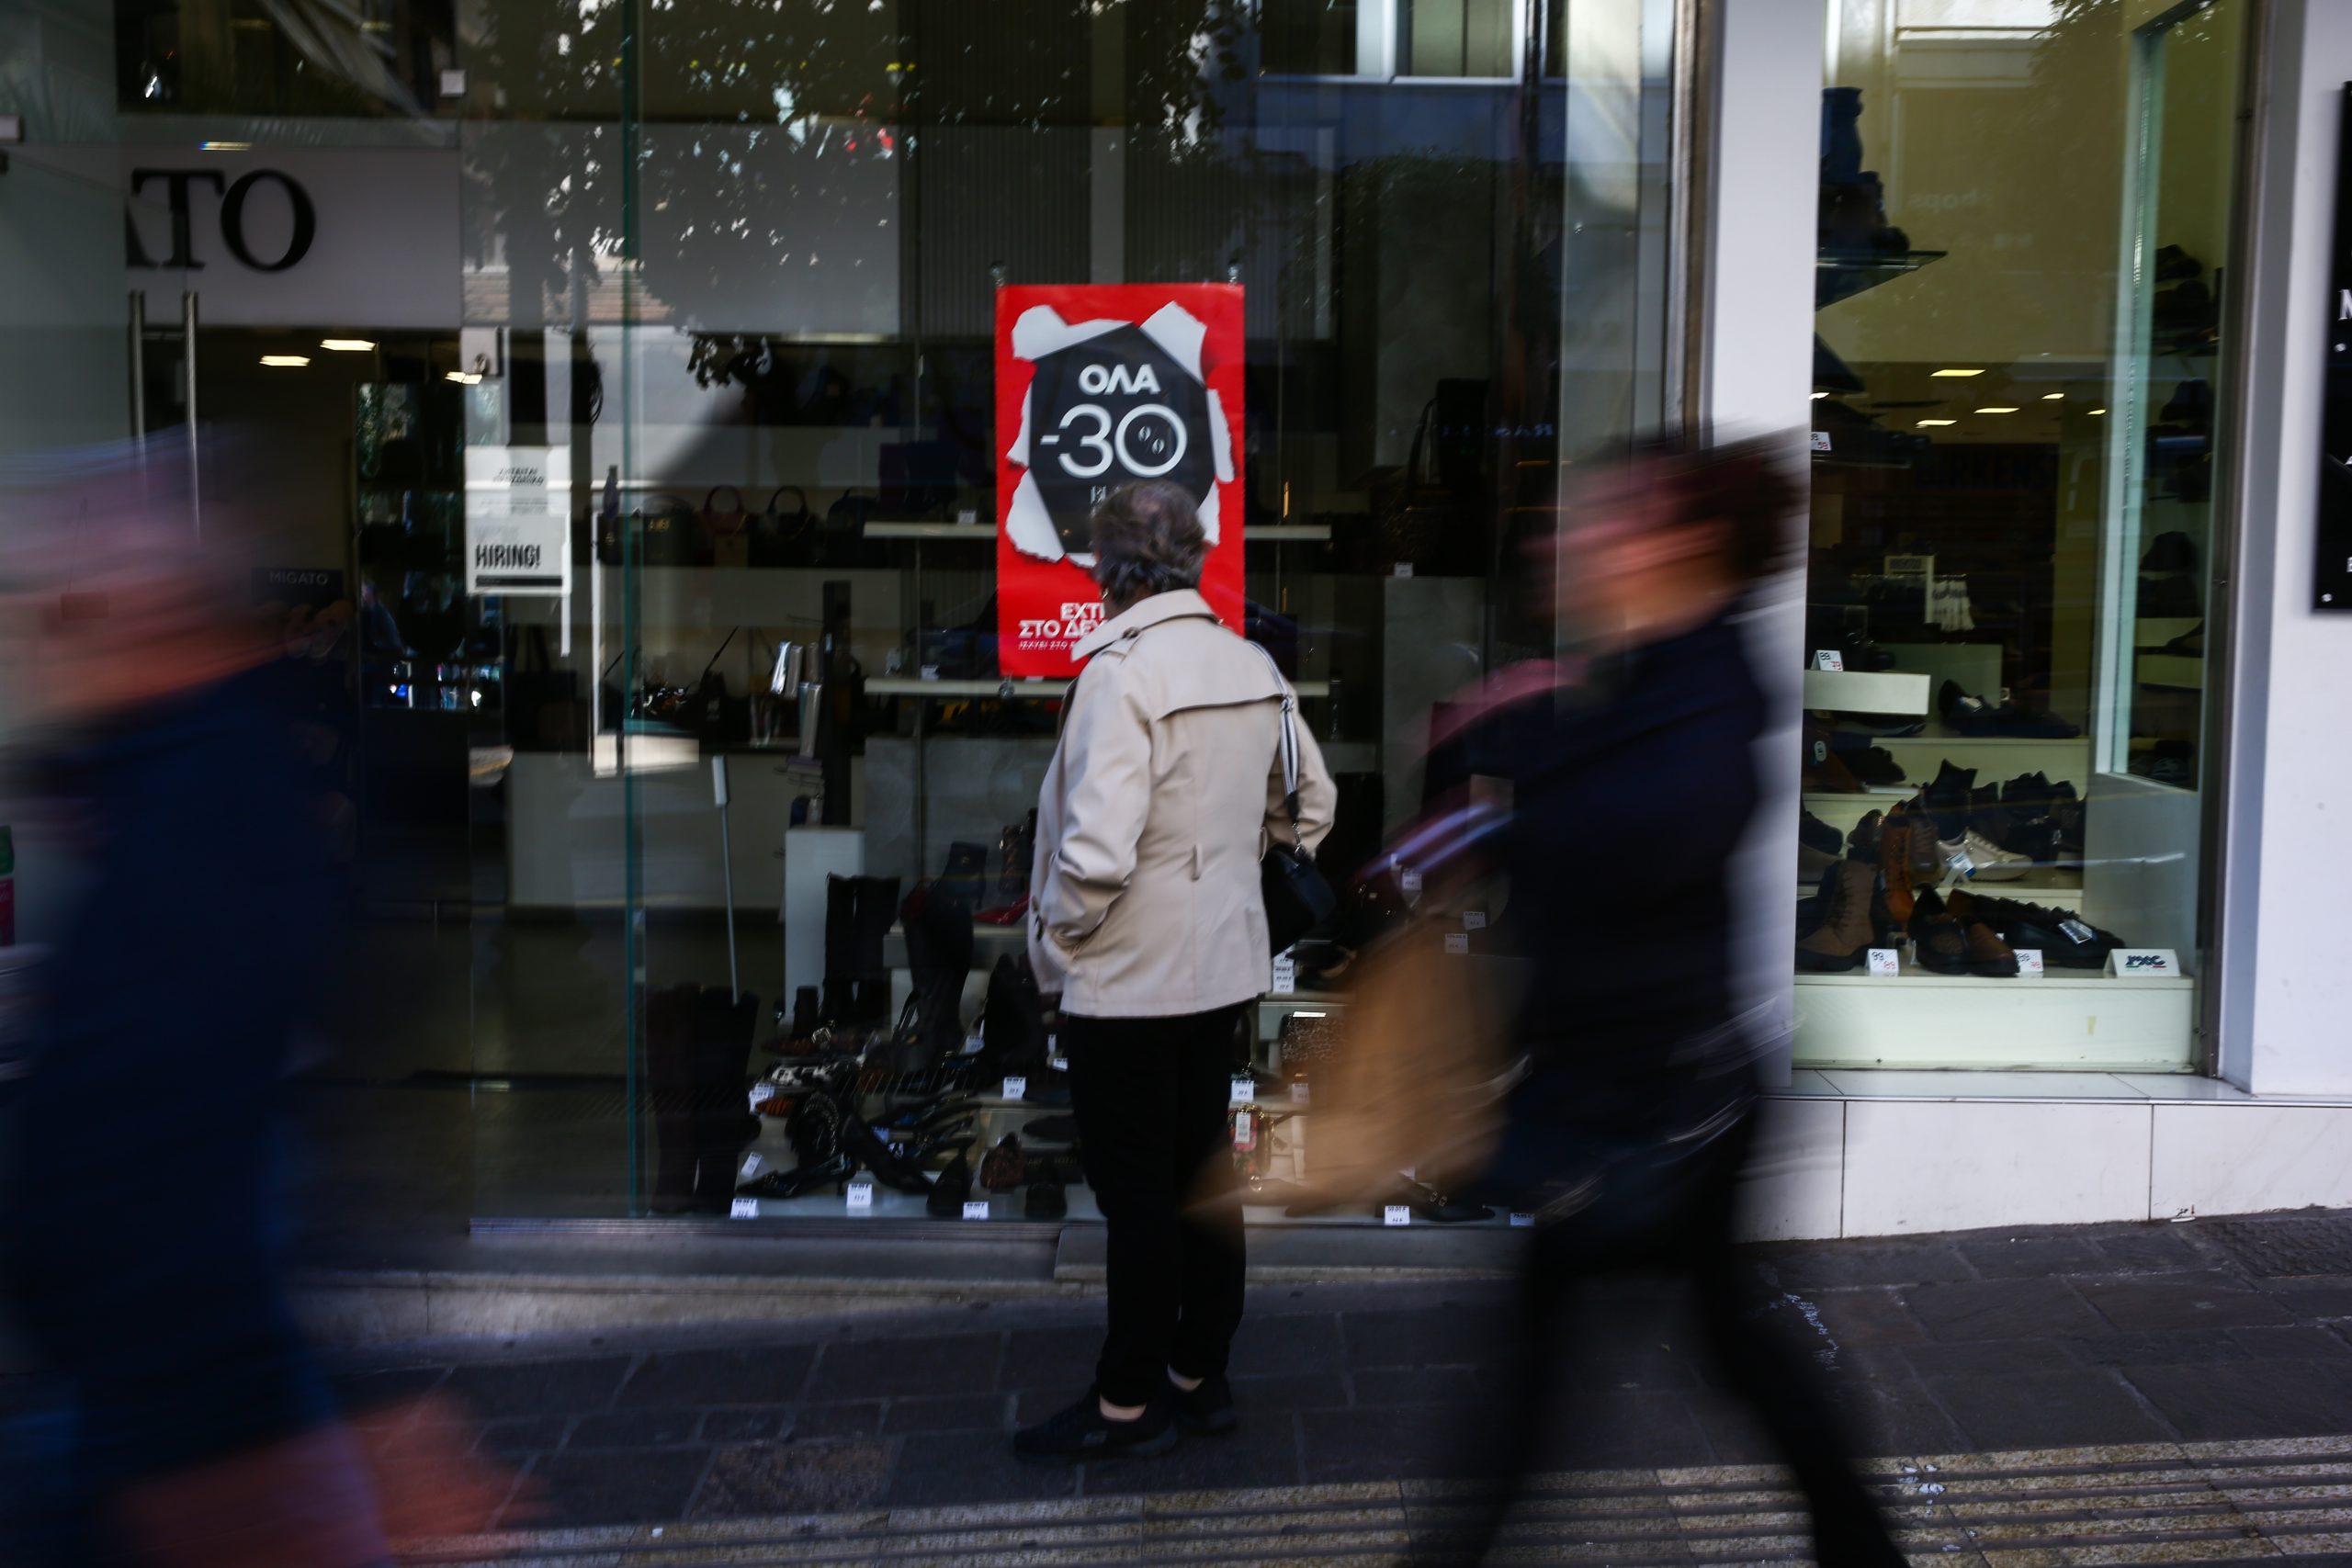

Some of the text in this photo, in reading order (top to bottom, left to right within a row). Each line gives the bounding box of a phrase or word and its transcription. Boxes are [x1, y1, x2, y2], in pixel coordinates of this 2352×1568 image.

[127, 169, 315, 272] TO
[1078, 364, 1161, 396] ΟΛΑ
[476, 544, 541, 569] HIRING!
[269, 571, 329, 586] MIGATO
